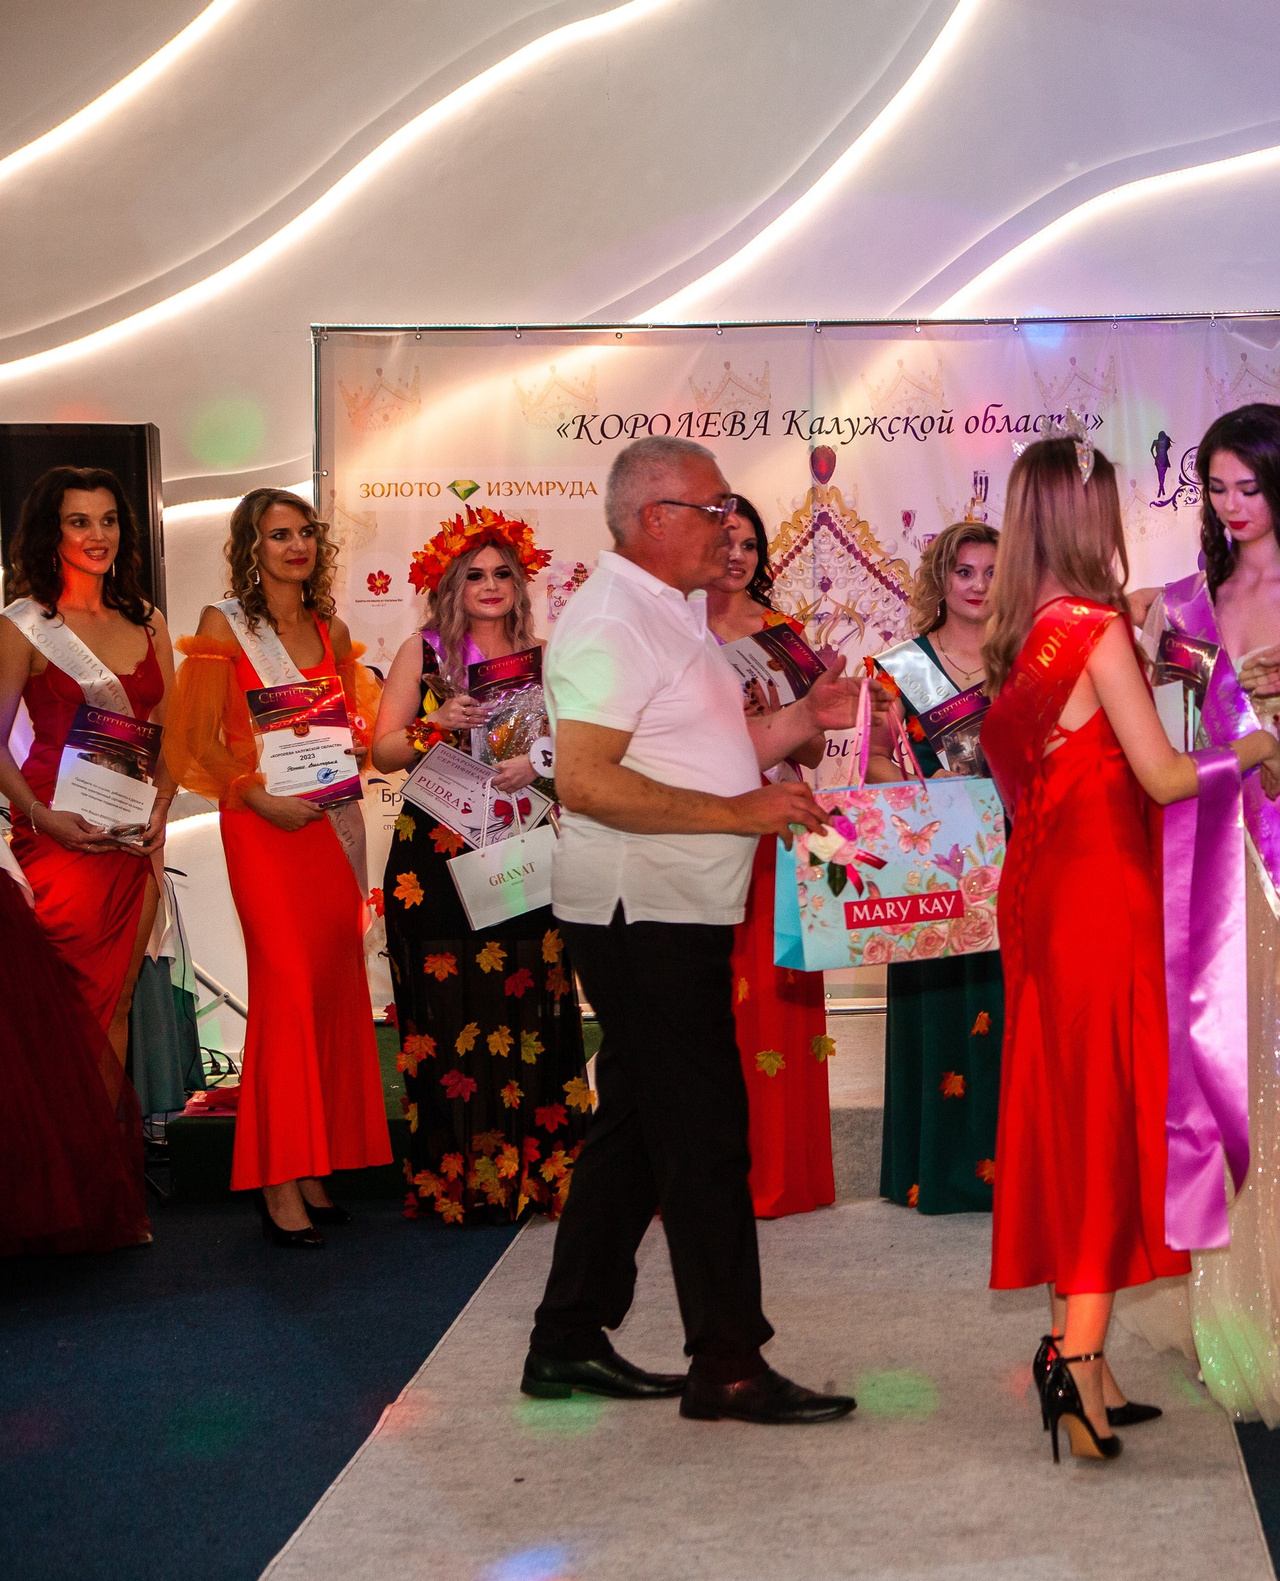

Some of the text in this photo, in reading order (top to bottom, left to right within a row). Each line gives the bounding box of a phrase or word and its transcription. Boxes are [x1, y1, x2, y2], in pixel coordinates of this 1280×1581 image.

[556, 403, 1104, 445] «КОРОЛЕВА Калужской област»
[359, 481, 599, 499] ЗОЛОТО ИЗУМРУДА
[27, 623, 96, 690] КОРОЛЕВА
[929, 688, 984, 723] CERTIFICAT
[300, 753, 316, 761] 2023
[417, 775, 460, 807] PUDRA
[489, 862, 535, 887] GRANAT
[852, 895, 956, 922] MARY KAY
